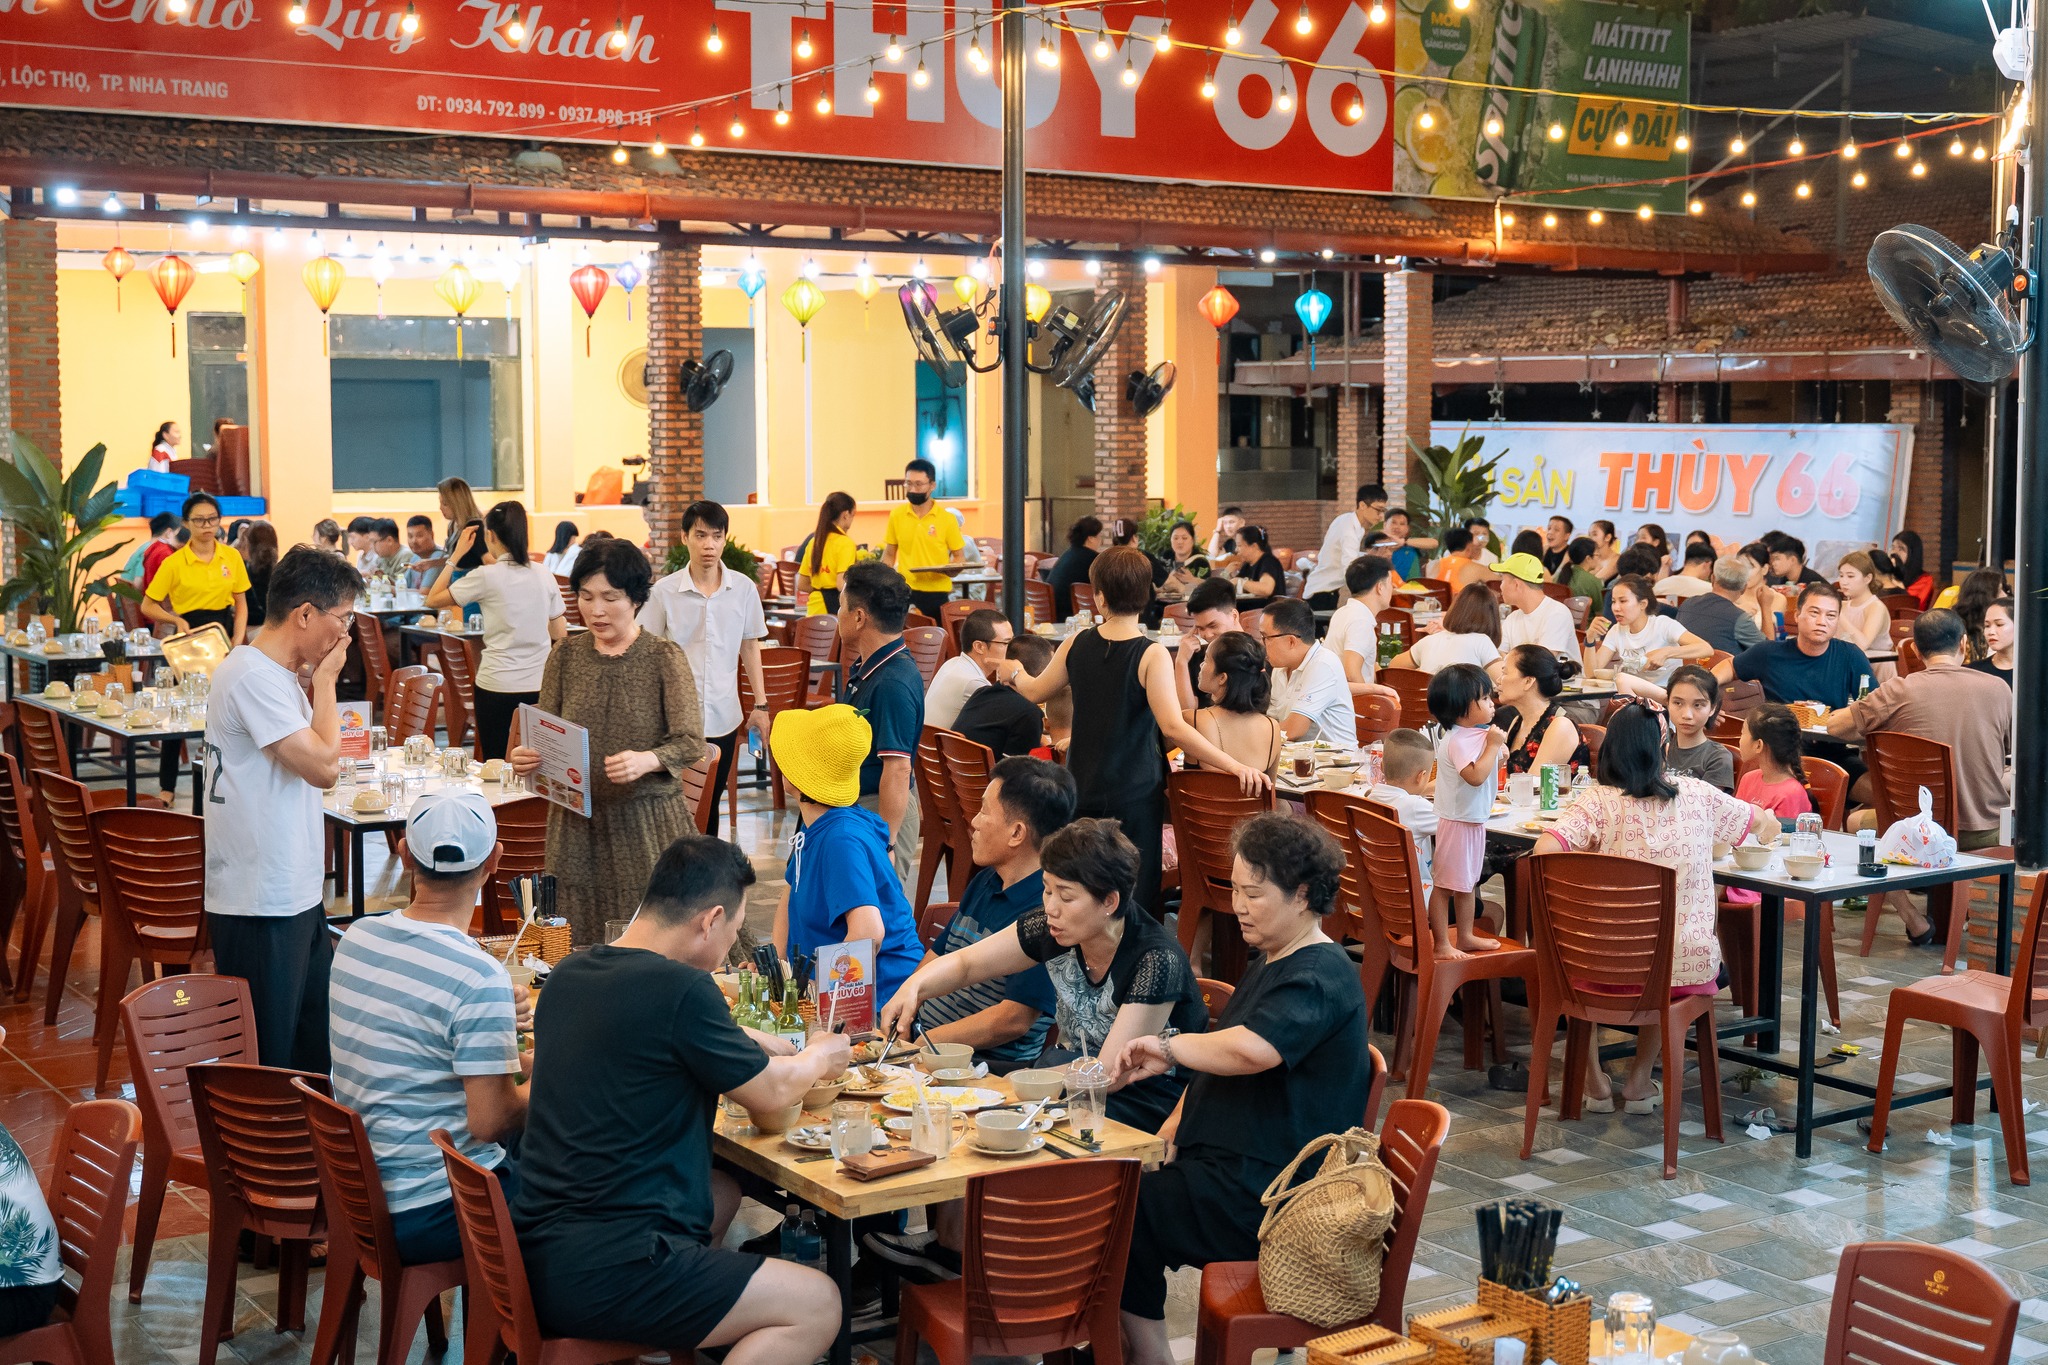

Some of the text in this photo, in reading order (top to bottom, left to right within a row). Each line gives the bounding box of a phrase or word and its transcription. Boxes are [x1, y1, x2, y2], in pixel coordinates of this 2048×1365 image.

[450, 0, 660, 64] Khách
[1591, 16, 1672, 53] MÁTTTTT
[11, 64, 46, 89] LỘC
[50, 70, 91, 92] THỌ,
[99, 74, 124, 92] TP.
[129, 77, 167, 95] NHA
[171, 79, 228, 99] TRANG
[1213, 0, 1387, 157] 66
[1583, 56, 1682, 89] LẠNHHHHH
[417, 94, 442, 112] ĐT:
[446, 97, 545, 119] 0934.792.899
[1499, 454, 1574, 507] SẢN
[1599, 438, 1772, 515] THÙY
[1776, 451, 1860, 518] 66
[853, 986, 864, 995] 66
